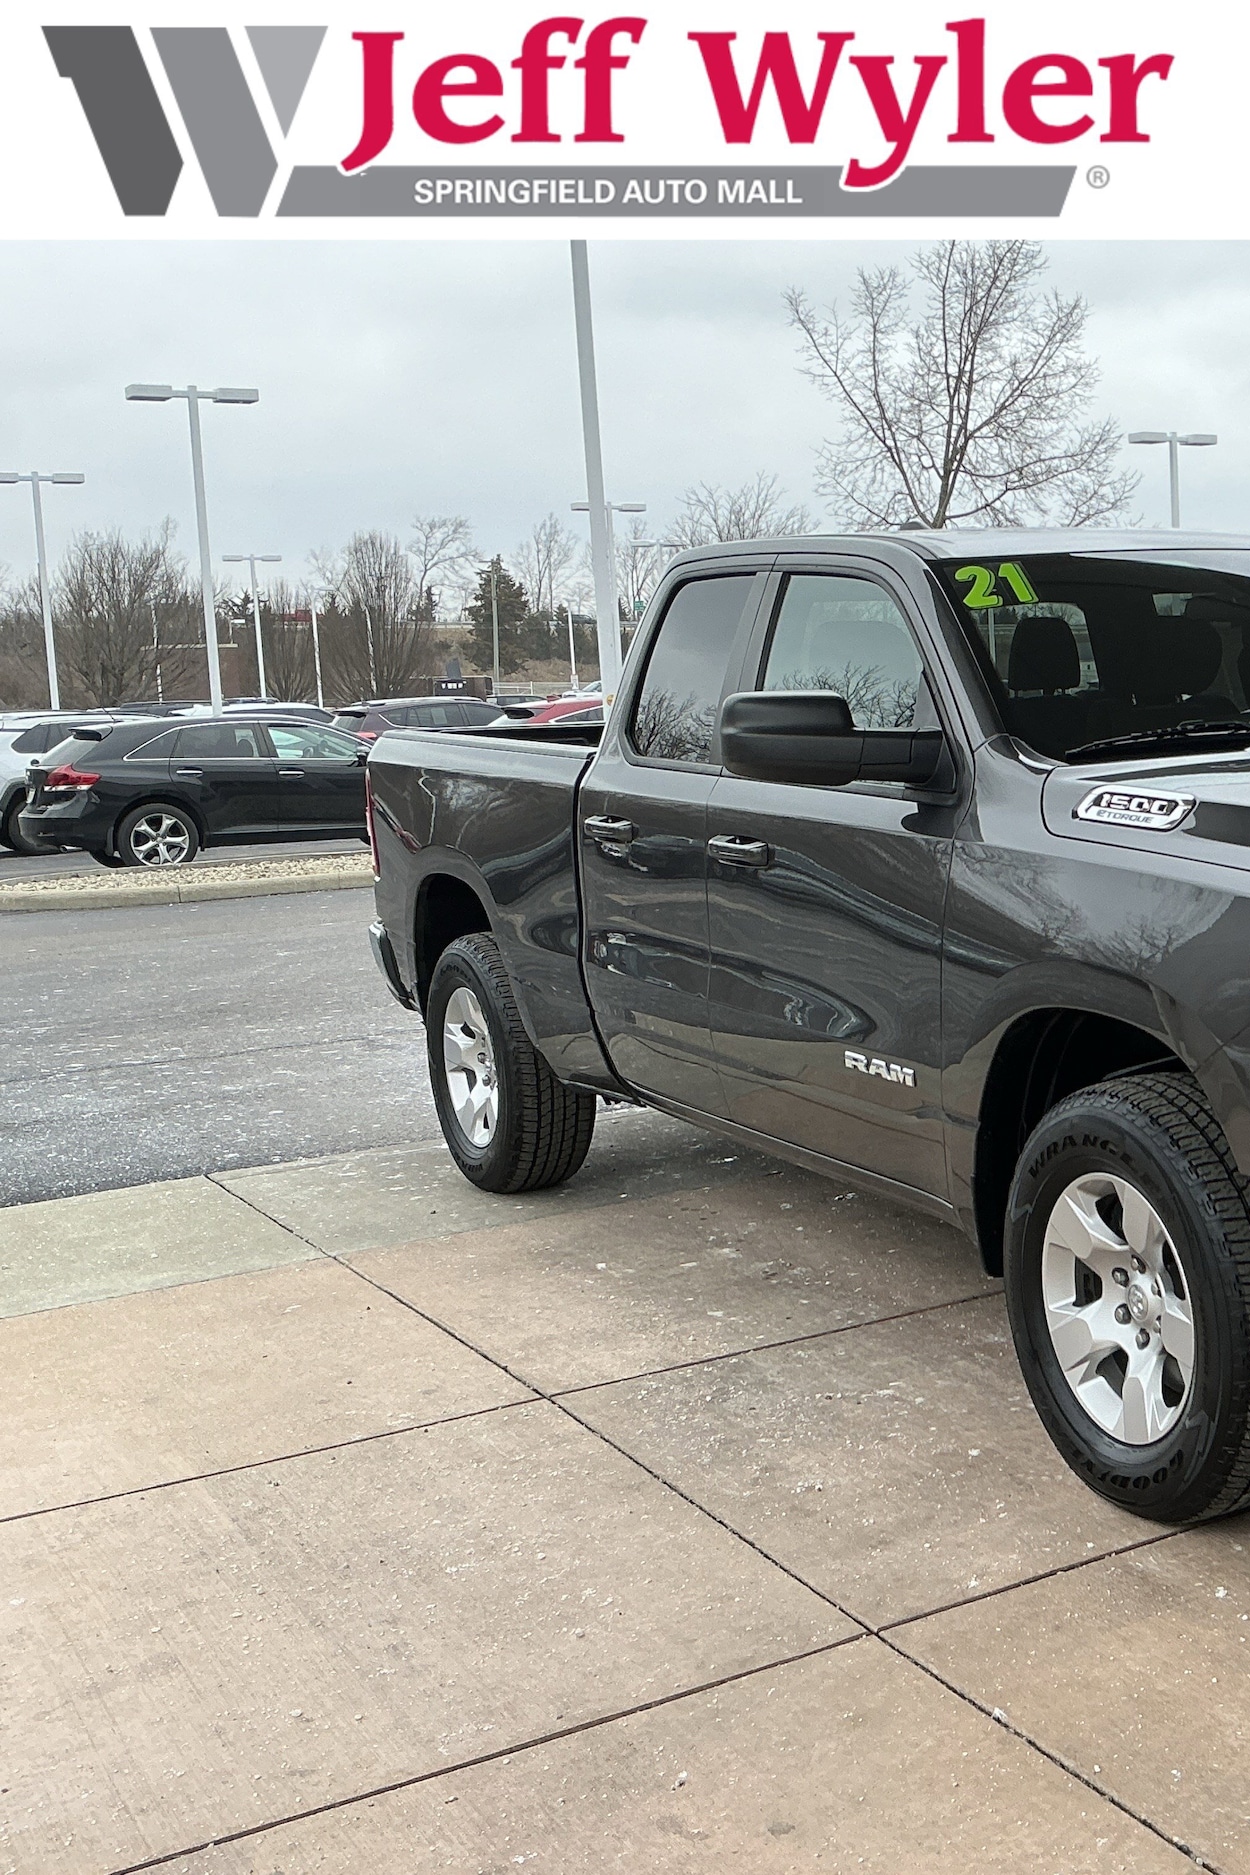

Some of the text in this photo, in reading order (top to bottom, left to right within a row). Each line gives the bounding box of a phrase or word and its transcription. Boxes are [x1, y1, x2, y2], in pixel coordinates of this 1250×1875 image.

[955, 563, 1039, 609] 21
[1100, 793, 1170, 815] 1500
[844, 1050, 916, 1088] RAM
